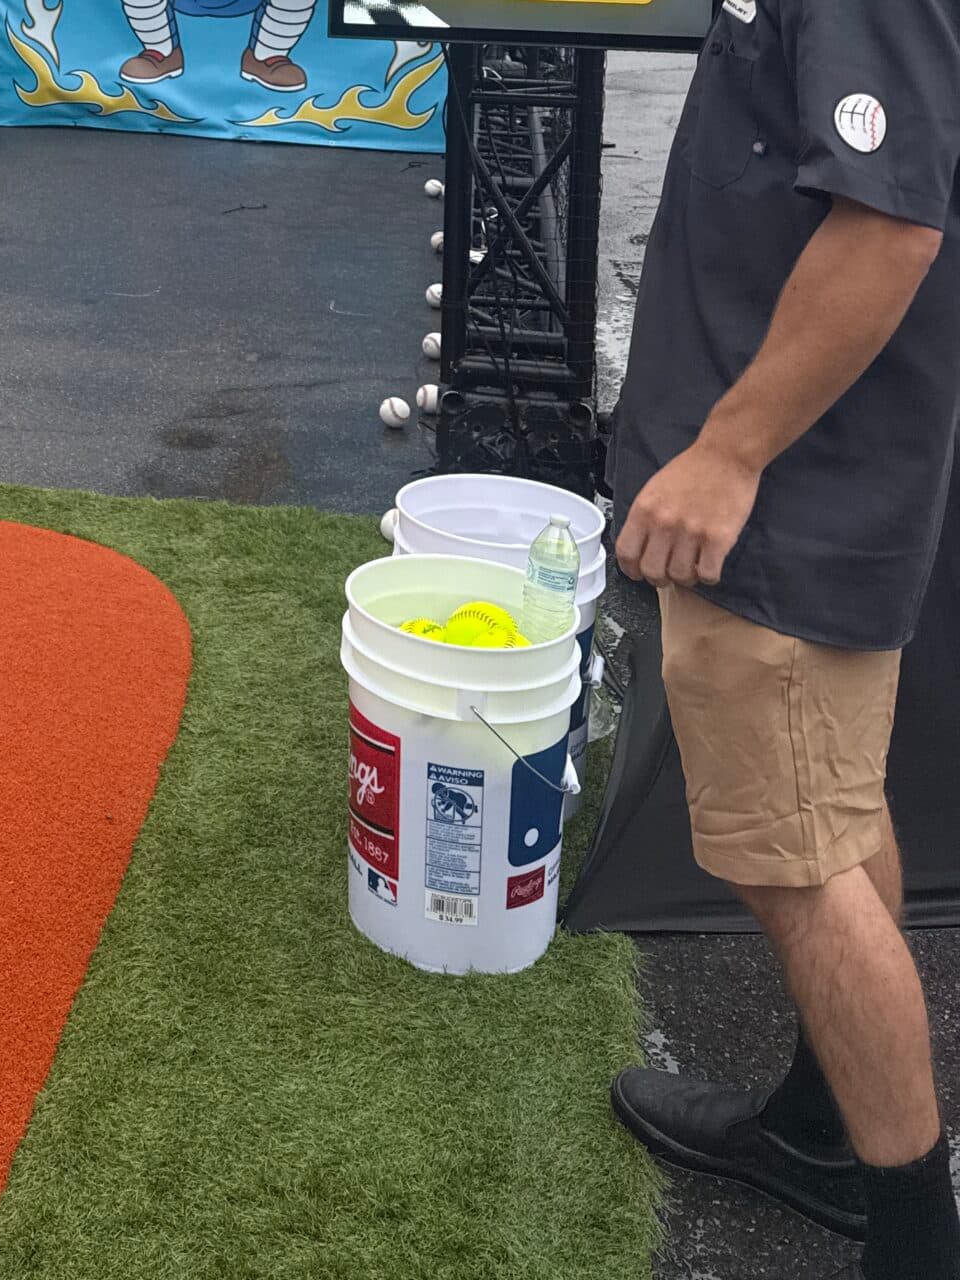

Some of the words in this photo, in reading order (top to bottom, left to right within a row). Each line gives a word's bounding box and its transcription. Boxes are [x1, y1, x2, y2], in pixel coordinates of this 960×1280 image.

[437, 767, 483, 778] WARNING
[438, 775, 469, 785] AVISO
[363, 836, 390, 864] 1887
